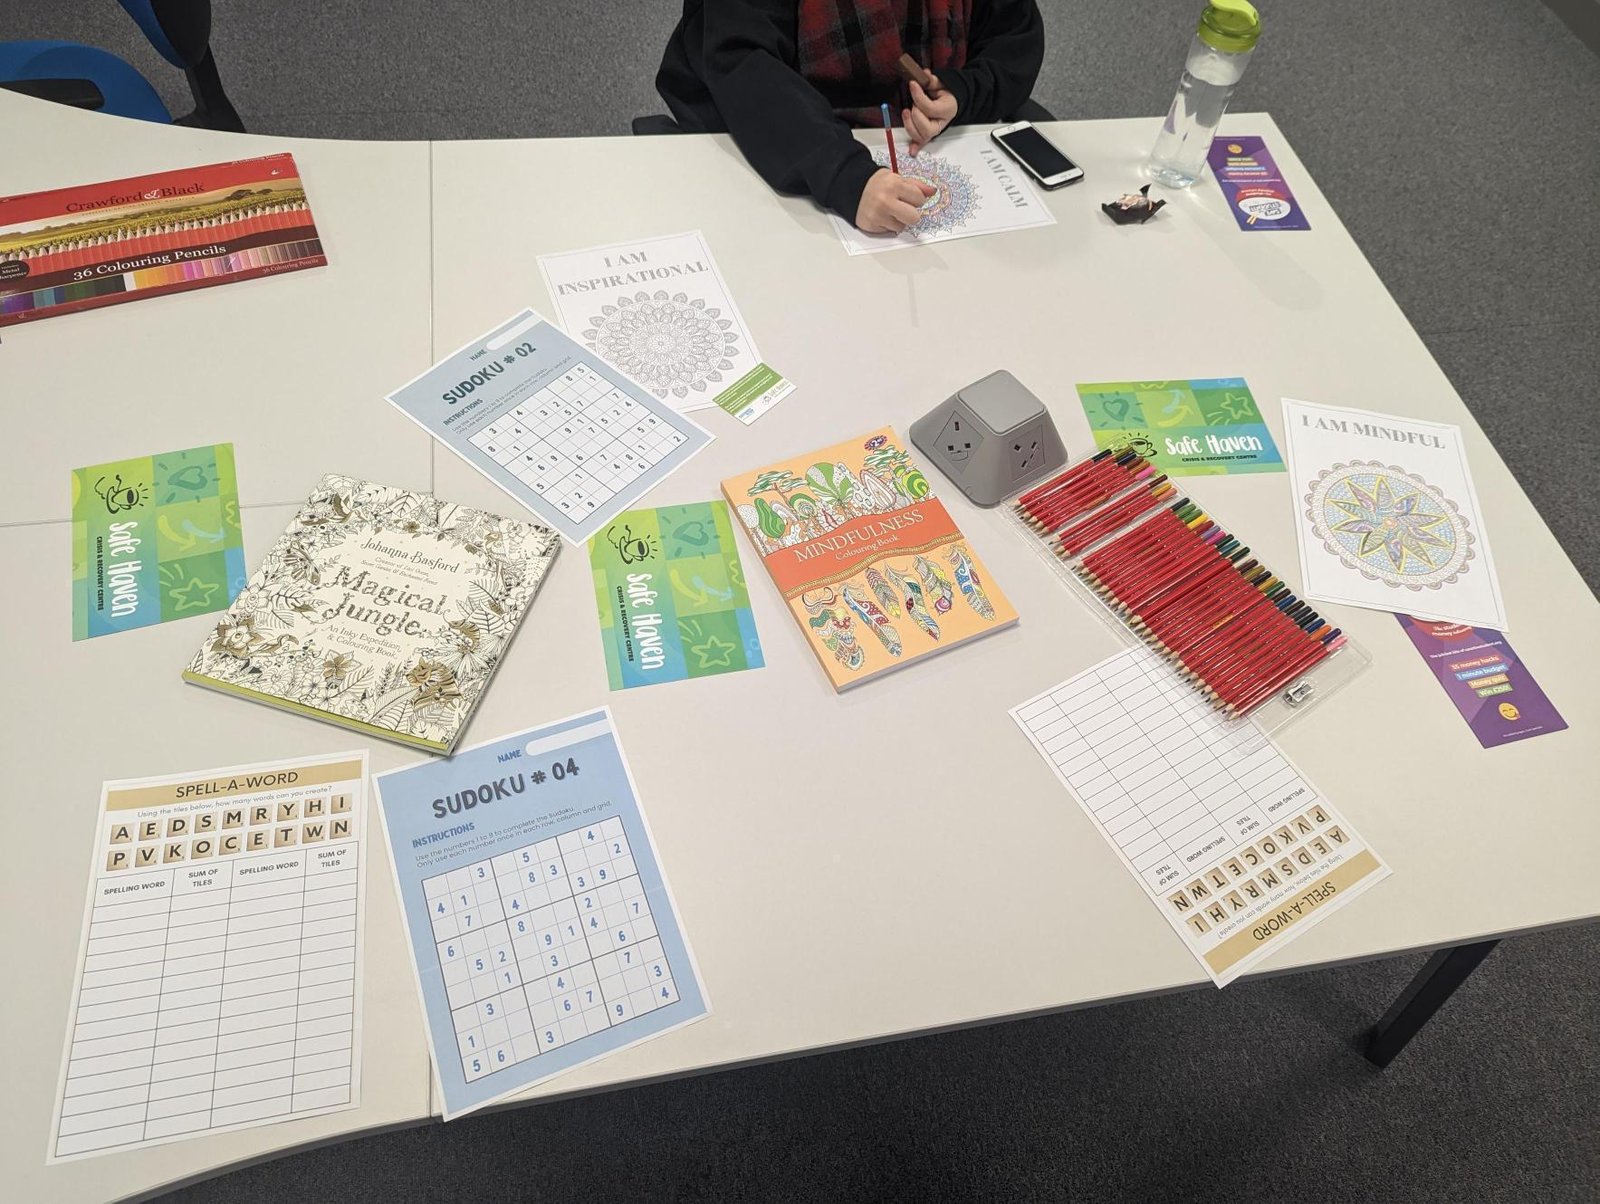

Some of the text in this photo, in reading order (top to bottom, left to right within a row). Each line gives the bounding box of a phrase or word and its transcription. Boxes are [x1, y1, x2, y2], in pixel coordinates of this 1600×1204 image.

[66, 192, 143, 212] Crawford
[144, 188, 160, 200] &
[161, 183, 205, 198] Black
[998, 175, 1028, 207] CALM
[73, 245, 226, 281] 36 Colouring Pencils
[271, 261, 298, 272] Colouring
[299, 258, 319, 266] Pencils
[604, 251, 648, 267] I AM
[557, 261, 709, 296] INSPIRATIONAL
[470, 349, 488, 361] NAME
[442, 342, 536, 404] SUDOKU # 02
[443, 398, 484, 426] INSTRUCTIONS
[1302, 414, 1446, 449] I AM MINDFUL
[1165, 434, 1263, 456] Safe Haven
[794, 509, 924, 562] MINDFULNESS
[835, 534, 899, 561] Colouring Book
[360, 537, 408, 559] Johanna
[410, 551, 460, 573] Basford
[107, 521, 142, 617] Safe Haven
[325, 565, 451, 616] Magical
[322, 592, 428, 637] Jungle
[617, 585, 625, 603] CRISIS
[621, 610, 630, 639] RECOVERY
[626, 640, 634, 662] CENTRE
[626, 573, 666, 670] Safe Haven
[322, 625, 400, 649] An Inky Expedition
[335, 635, 376, 651] Colouring
[497, 749, 522, 763] NAME
[176, 772, 298, 798] SPELL-A-WORD
[432, 757, 580, 819] SUDOKU # 04
[138, 810, 158, 818] Using
[190, 803, 214, 811] below,
[232, 797, 251, 807] many
[253, 793, 275, 801] words
[291, 790, 304, 798] you
[305, 786, 332, 795] create?
[1268, 788, 1305, 813] SPELLING WORD
[115, 797, 344, 840] A E D S M R Y H I
[1236, 815, 1251, 826] TILES
[1240, 820, 1260, 836] SUM OF
[114, 820, 347, 865] P V K O C E T W N
[412, 822, 475, 848] INSTRUCTIONS
[416, 853, 429, 861] Use
[430, 848, 443, 857] the
[443, 839, 475, 853] numbers
[488, 831, 494, 839] 9
[503, 820, 535, 834] complete
[536, 815, 548, 823] the
[417, 859, 434, 868] Only
[435, 854, 448, 862] use
[449, 848, 467, 858] each
[468, 839, 496, 852] number
[496, 833, 514, 842] once
[523, 824, 541, 834] each
[556, 811, 581, 822] column
[582, 805, 596, 814] and
[1186, 836, 1226, 863] SPELLING WORD
[1328, 855, 1344, 865] Using
[239, 861, 299, 875] SPELLING WORD
[1155, 864, 1171, 875] TILES
[1167, 870, 1180, 881] SUM
[1310, 867, 1320, 876] tiles
[1320, 862, 1328, 870] the
[104, 881, 165, 895] SPELLING WORD
[192, 879, 212, 887] TILES
[1270, 891, 1284, 901] many
[1284, 884, 1296, 893] how
[1246, 909, 1256, 918] can
[1252, 881, 1336, 941] SPELL-A-WORD
[1255, 899, 1270, 911] words
[1236, 914, 1246, 925] you
